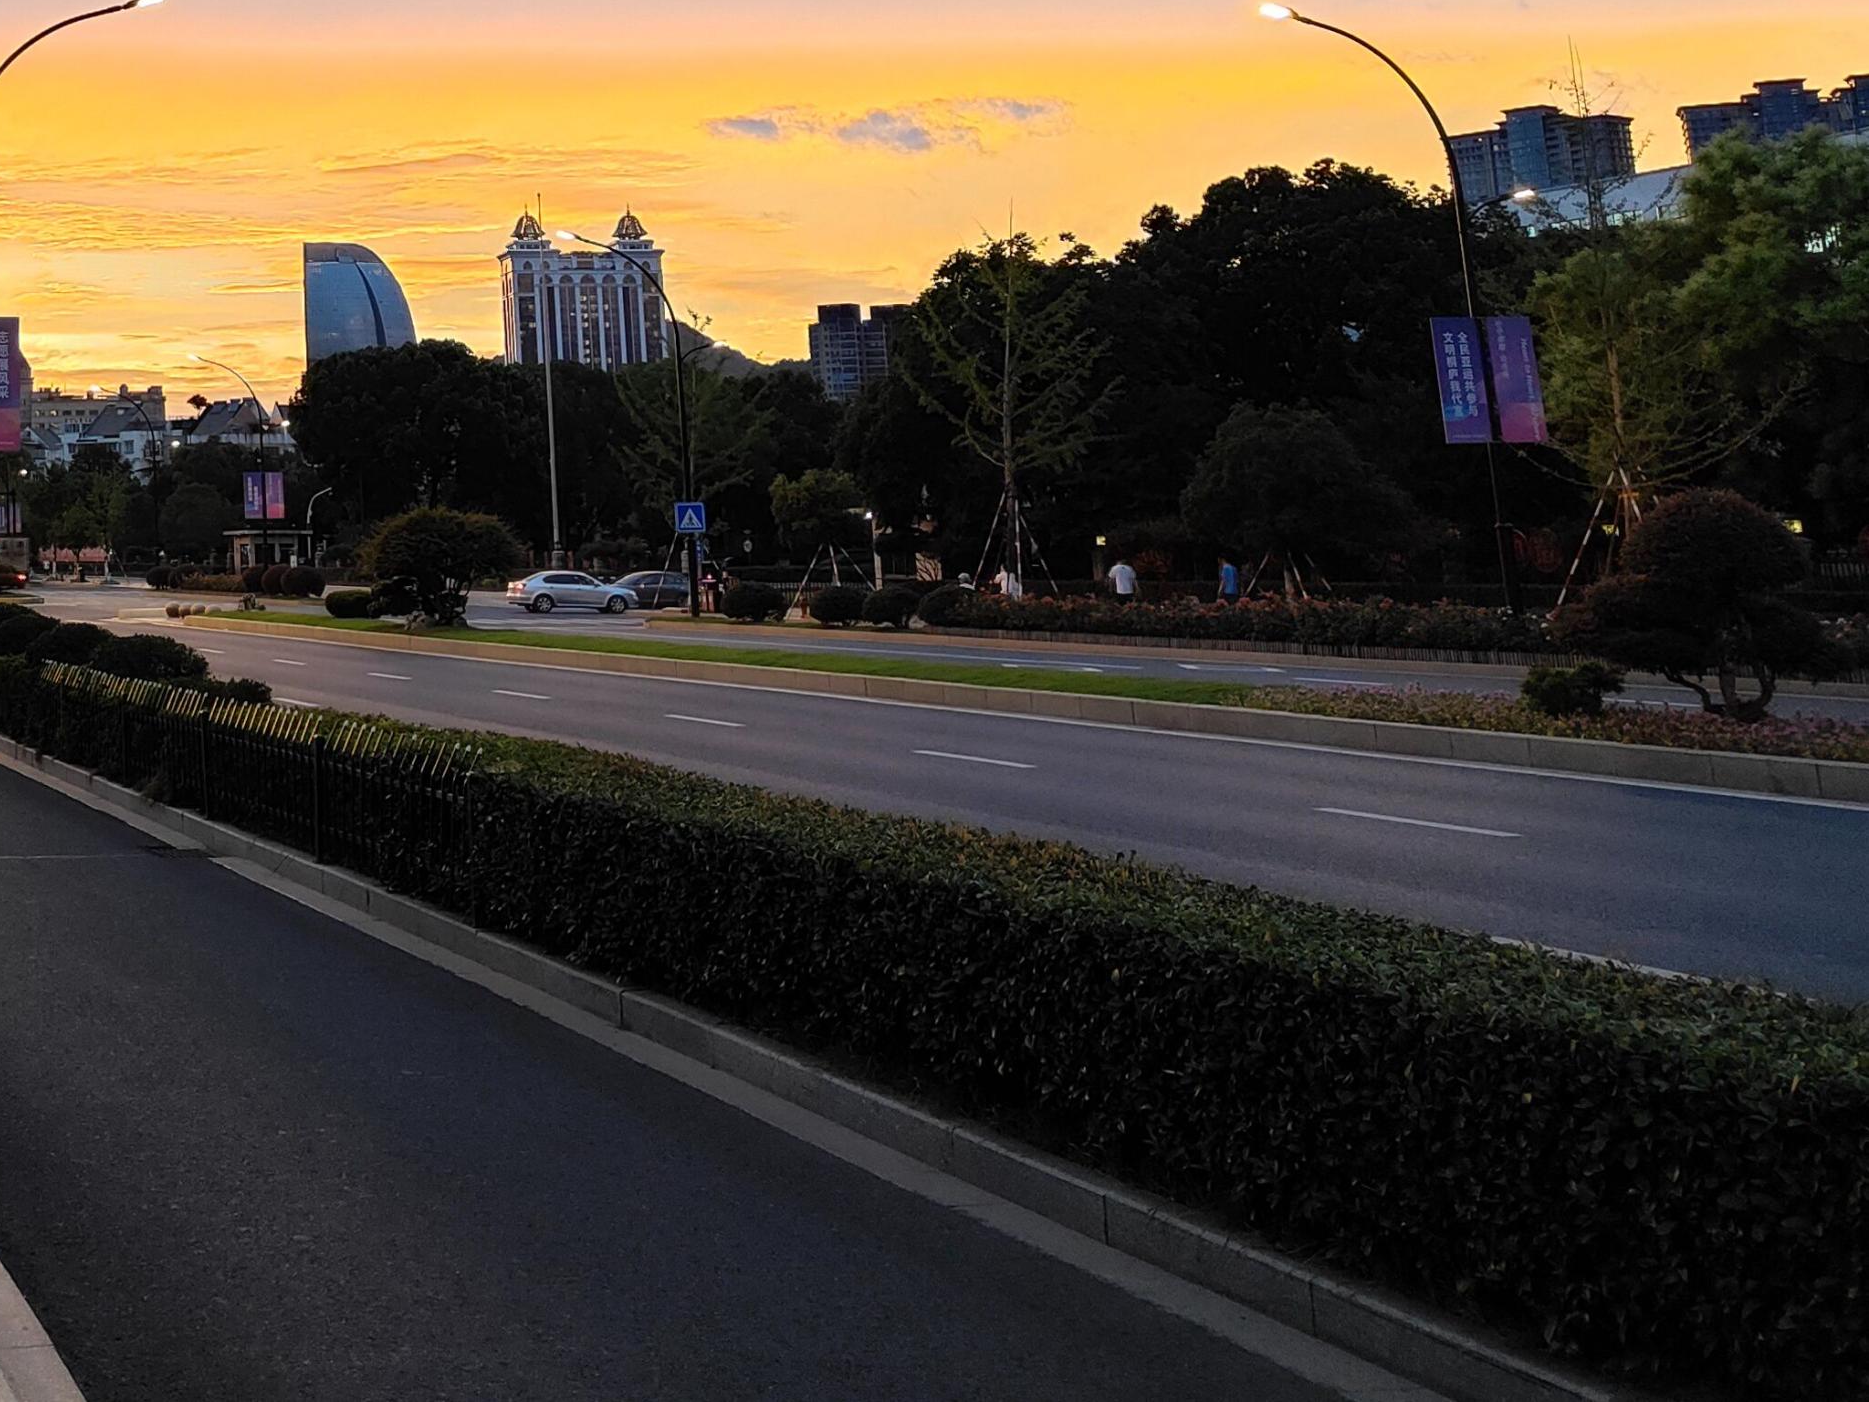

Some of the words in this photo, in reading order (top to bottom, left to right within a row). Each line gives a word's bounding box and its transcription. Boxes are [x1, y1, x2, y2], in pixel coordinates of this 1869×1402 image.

[1457, 331, 1478, 417] 全民亚运共参与
